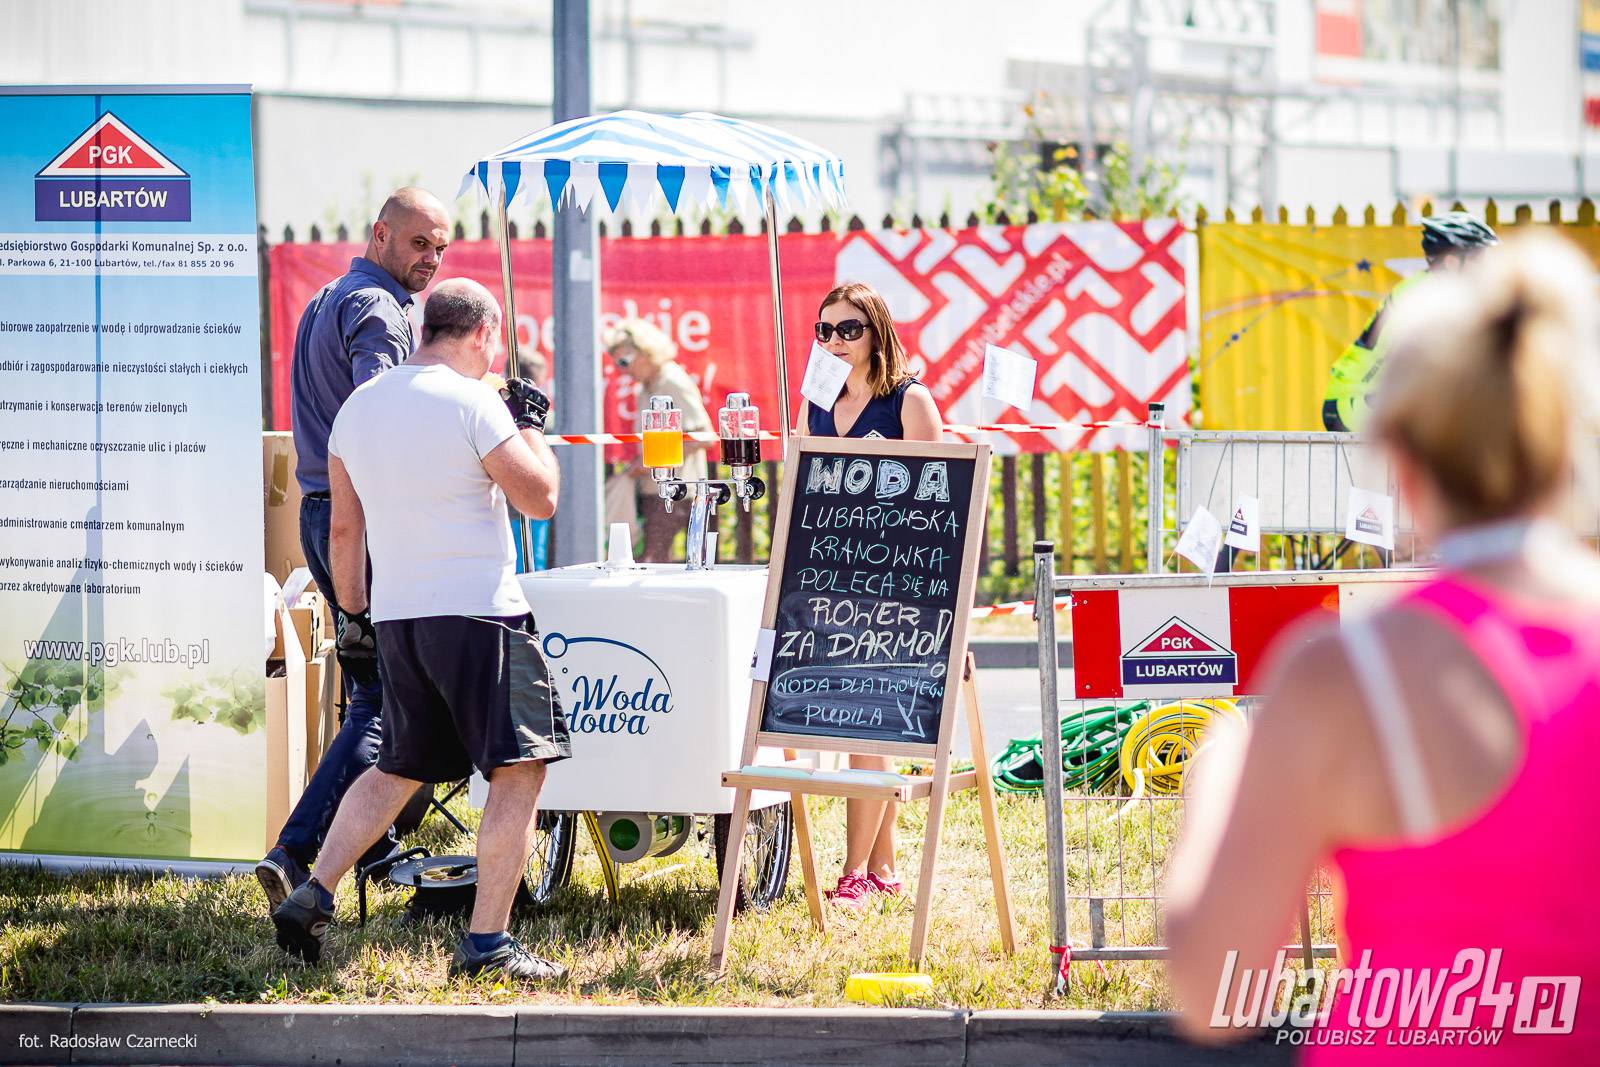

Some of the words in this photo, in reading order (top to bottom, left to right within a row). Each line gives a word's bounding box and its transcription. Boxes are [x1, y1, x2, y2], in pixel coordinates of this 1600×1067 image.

[88, 145, 133, 165] PGK
[59, 186, 168, 208] LUBARTÓW
[71, 240, 129, 254] Gospodarki
[132, 241, 194, 254] Komunalnej
[197, 241, 215, 254] Sp.
[218, 243, 224, 252] z
[227, 243, 248, 252] o.o.
[7, 258, 46, 267] Parkowa
[48, 258, 57, 268] 6,
[60, 259, 92, 267] 21-100
[94, 258, 140, 269] Lubartów,
[143, 259, 175, 269] tel./fax
[178, 260, 188, 268] 81
[190, 260, 207, 268] 855
[210, 260, 220, 268] 20
[223, 260, 235, 268] 96
[35, 322, 90, 334] zaopatrzenie
[92, 325, 99, 333] w
[101, 322, 126, 335] wodę
[133, 323, 201, 336] odprowadzanie
[203, 322, 241, 334] ścieków
[30, 361, 110, 374] zagospodarowanie
[112, 362, 167, 375] nieczystości
[169, 362, 201, 375] stałych
[209, 363, 248, 376] ciekłych
[51, 400, 104, 414] konserwacja
[106, 402, 143, 412] terenów
[144, 402, 188, 415] zielonych
[0, 440, 25, 452] ęczne
[32, 440, 88, 451] mechaniczne
[90, 441, 146, 453] oczyszczanie
[148, 442, 166, 452] ulic
[174, 442, 207, 454] placów
[49, 480, 129, 491] nieruchomościami
[805, 457, 950, 502] WODA
[70, 520, 124, 530] cmentarzem
[126, 520, 185, 533] komunalnym
[801, 502, 960, 538] LUBARTOWSKA
[809, 530, 950, 574] KRANÓWKA
[56, 558, 82, 569] analiz
[84, 558, 171, 573] fizyko-chemicznych
[173, 561, 197, 573] wody
[205, 561, 244, 572] ścieków
[22, 581, 81, 594] akredytowane
[84, 583, 141, 594] laboratorium
[797, 567, 895, 598] POLECA
[902, 574, 925, 598] SIĘ
[927, 579, 950, 598] NA
[808, 597, 922, 627] ROWER
[24, 637, 210, 669] www.pgk.lub.pl
[776, 630, 816, 661] ZA
[1161, 637, 1194, 650] PGK
[1136, 662, 1224, 677] LUBARTÓW
[572, 675, 674, 713] Woda
[775, 676, 830, 695] WODA
[839, 678, 875, 695] DLA
[564, 702, 649, 735] dowa
[802, 703, 883, 726] PUPILA
